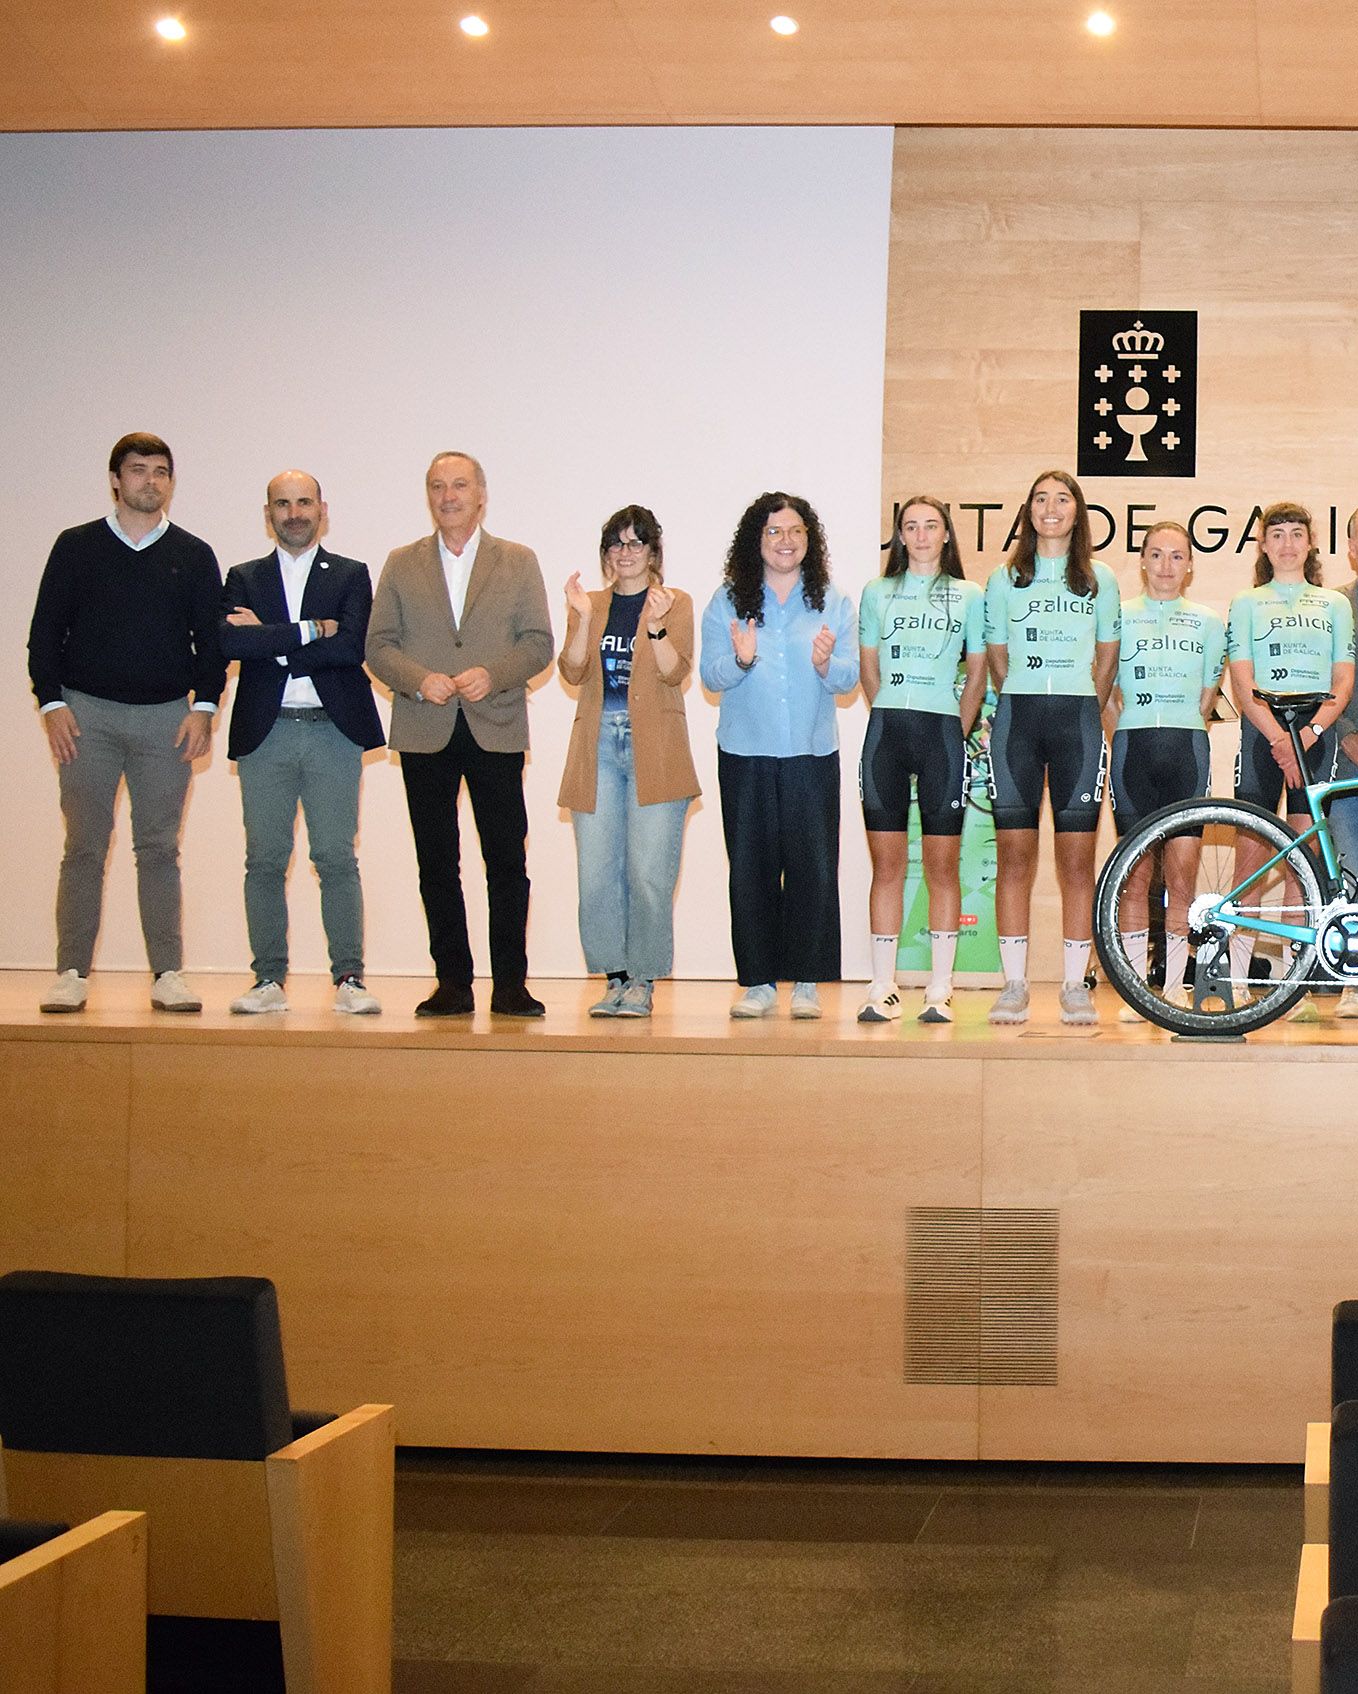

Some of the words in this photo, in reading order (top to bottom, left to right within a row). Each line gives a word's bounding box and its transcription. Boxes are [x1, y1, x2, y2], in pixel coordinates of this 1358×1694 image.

[1011, 596, 1094, 622] galicia
[881, 613, 962, 640] galicia
[1254, 614, 1333, 641] galicia
[1120, 635, 1204, 662] galicia
